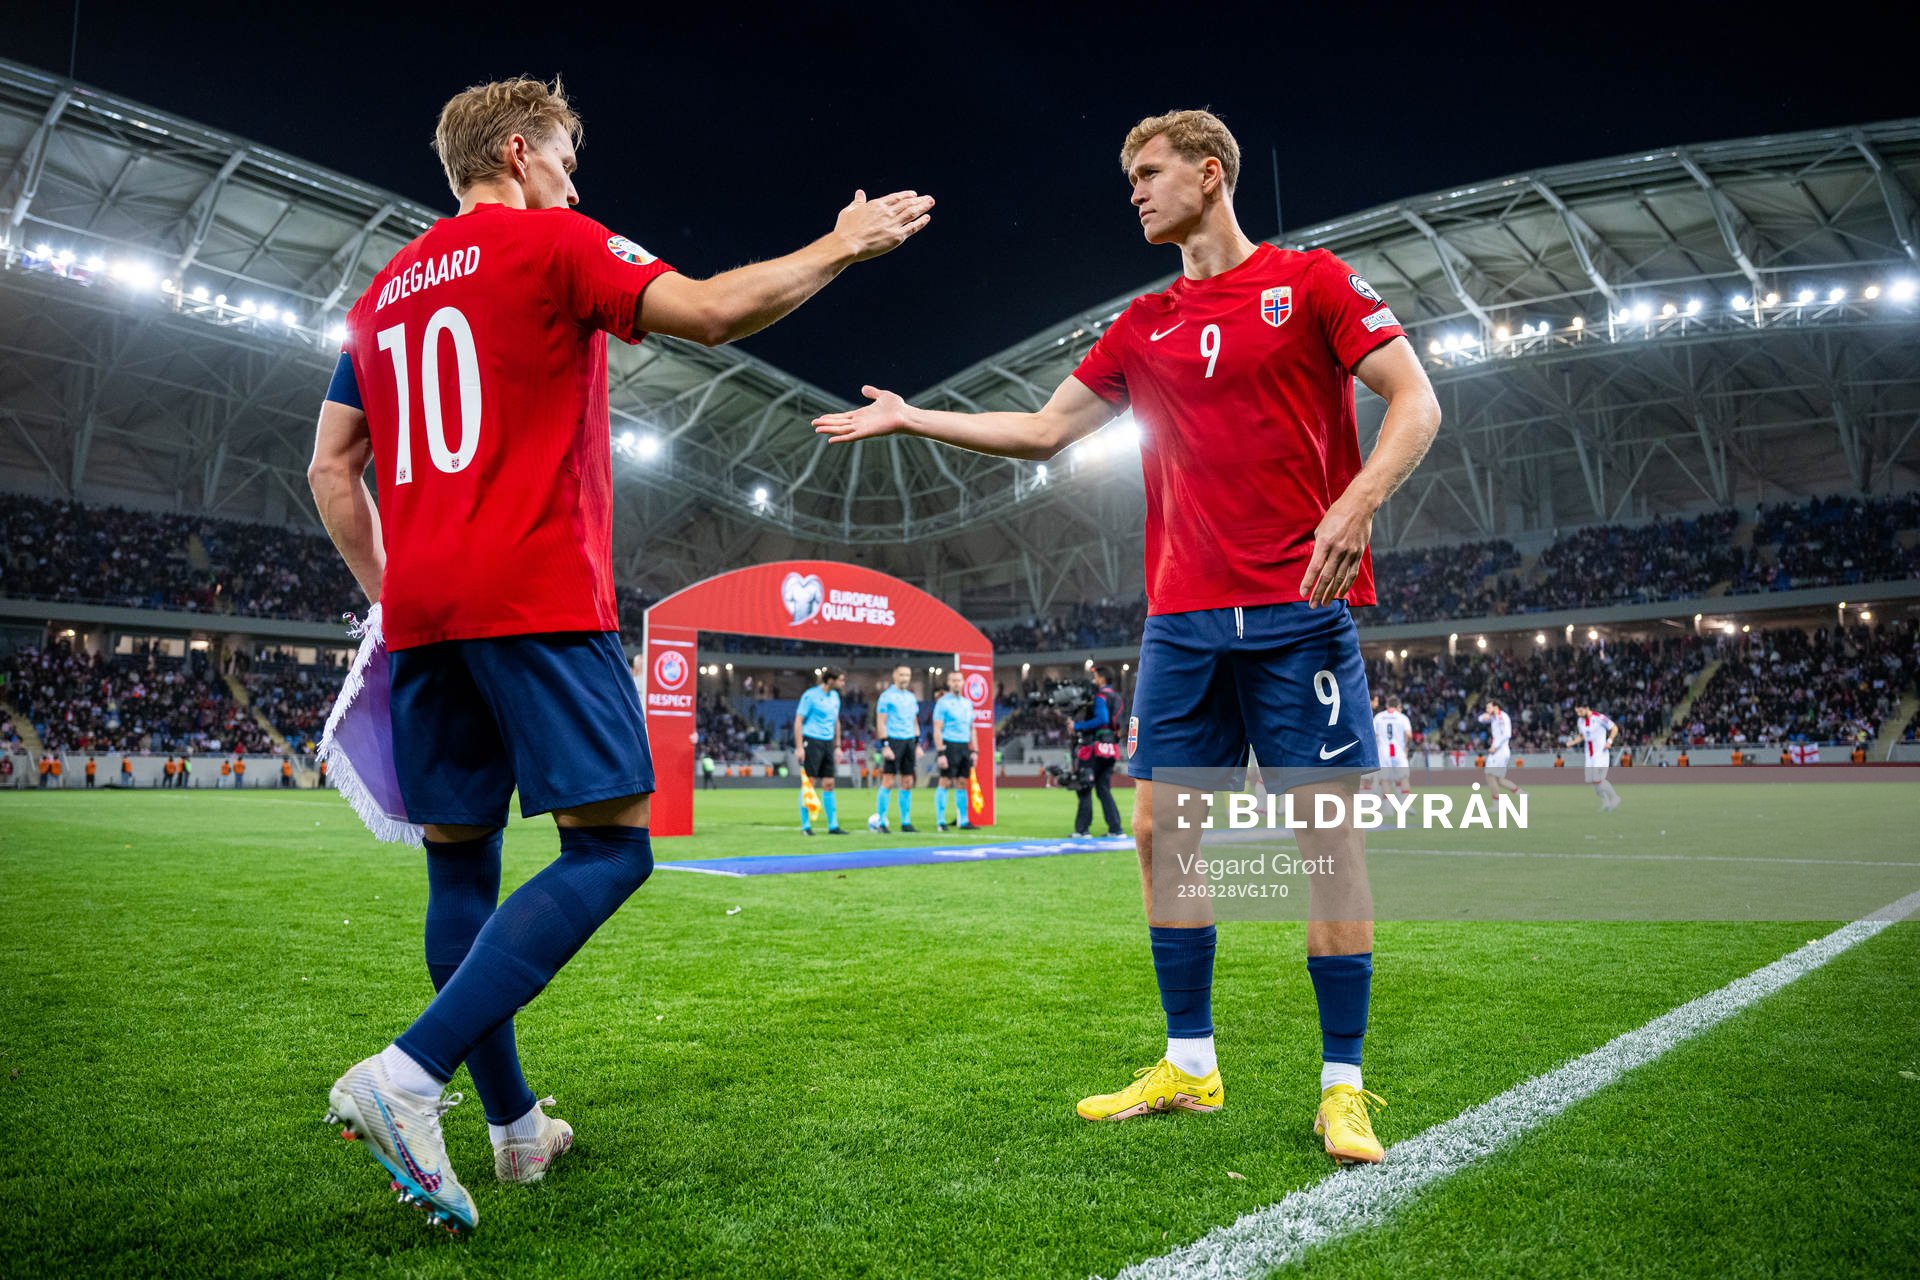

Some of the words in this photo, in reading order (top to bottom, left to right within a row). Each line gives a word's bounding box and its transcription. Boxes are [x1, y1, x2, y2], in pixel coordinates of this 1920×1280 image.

[375, 246, 481, 312] ØDEGAARD
[1200, 324, 1221, 379] 9
[377, 306, 482, 486] 10
[822, 602, 896, 626] QUALIFIERS
[830, 589, 889, 610] EUROPEAN
[648, 693, 692, 707] RESPECT
[1313, 670, 1341, 727] 9
[1386, 722, 1393, 740] 9
